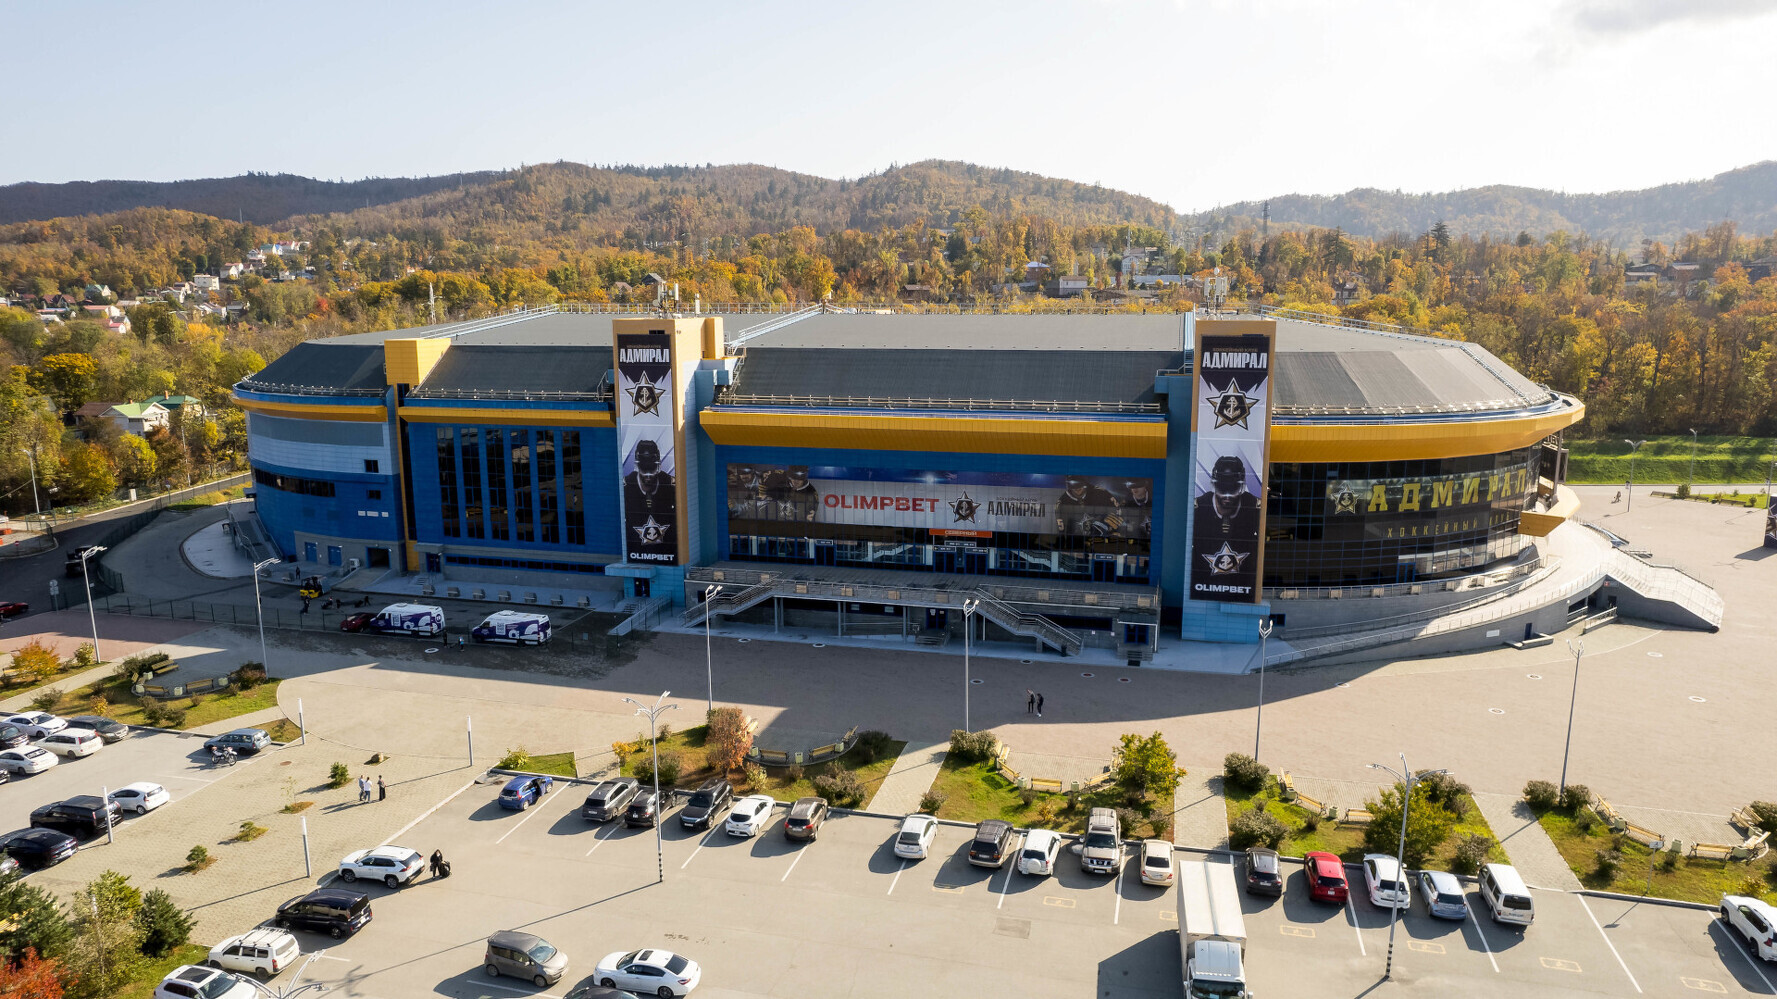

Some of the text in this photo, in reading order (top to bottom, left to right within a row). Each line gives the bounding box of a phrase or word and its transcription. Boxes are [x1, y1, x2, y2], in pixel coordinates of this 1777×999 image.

[620, 348, 670, 363] АДМИРАЛ
[1202, 352, 1268, 369] АДМИРАЛ
[1367, 468, 1527, 512] АДМИРАЛ
[824, 494, 940, 512] OLIMPBET
[987, 501, 1046, 517] АДМИРАЛ
[1387, 518, 1478, 538] ХОККЕЙНЫЙ
[630, 552, 675, 561] OLIMPBET
[1195, 584, 1252, 594] OLIMPBET
